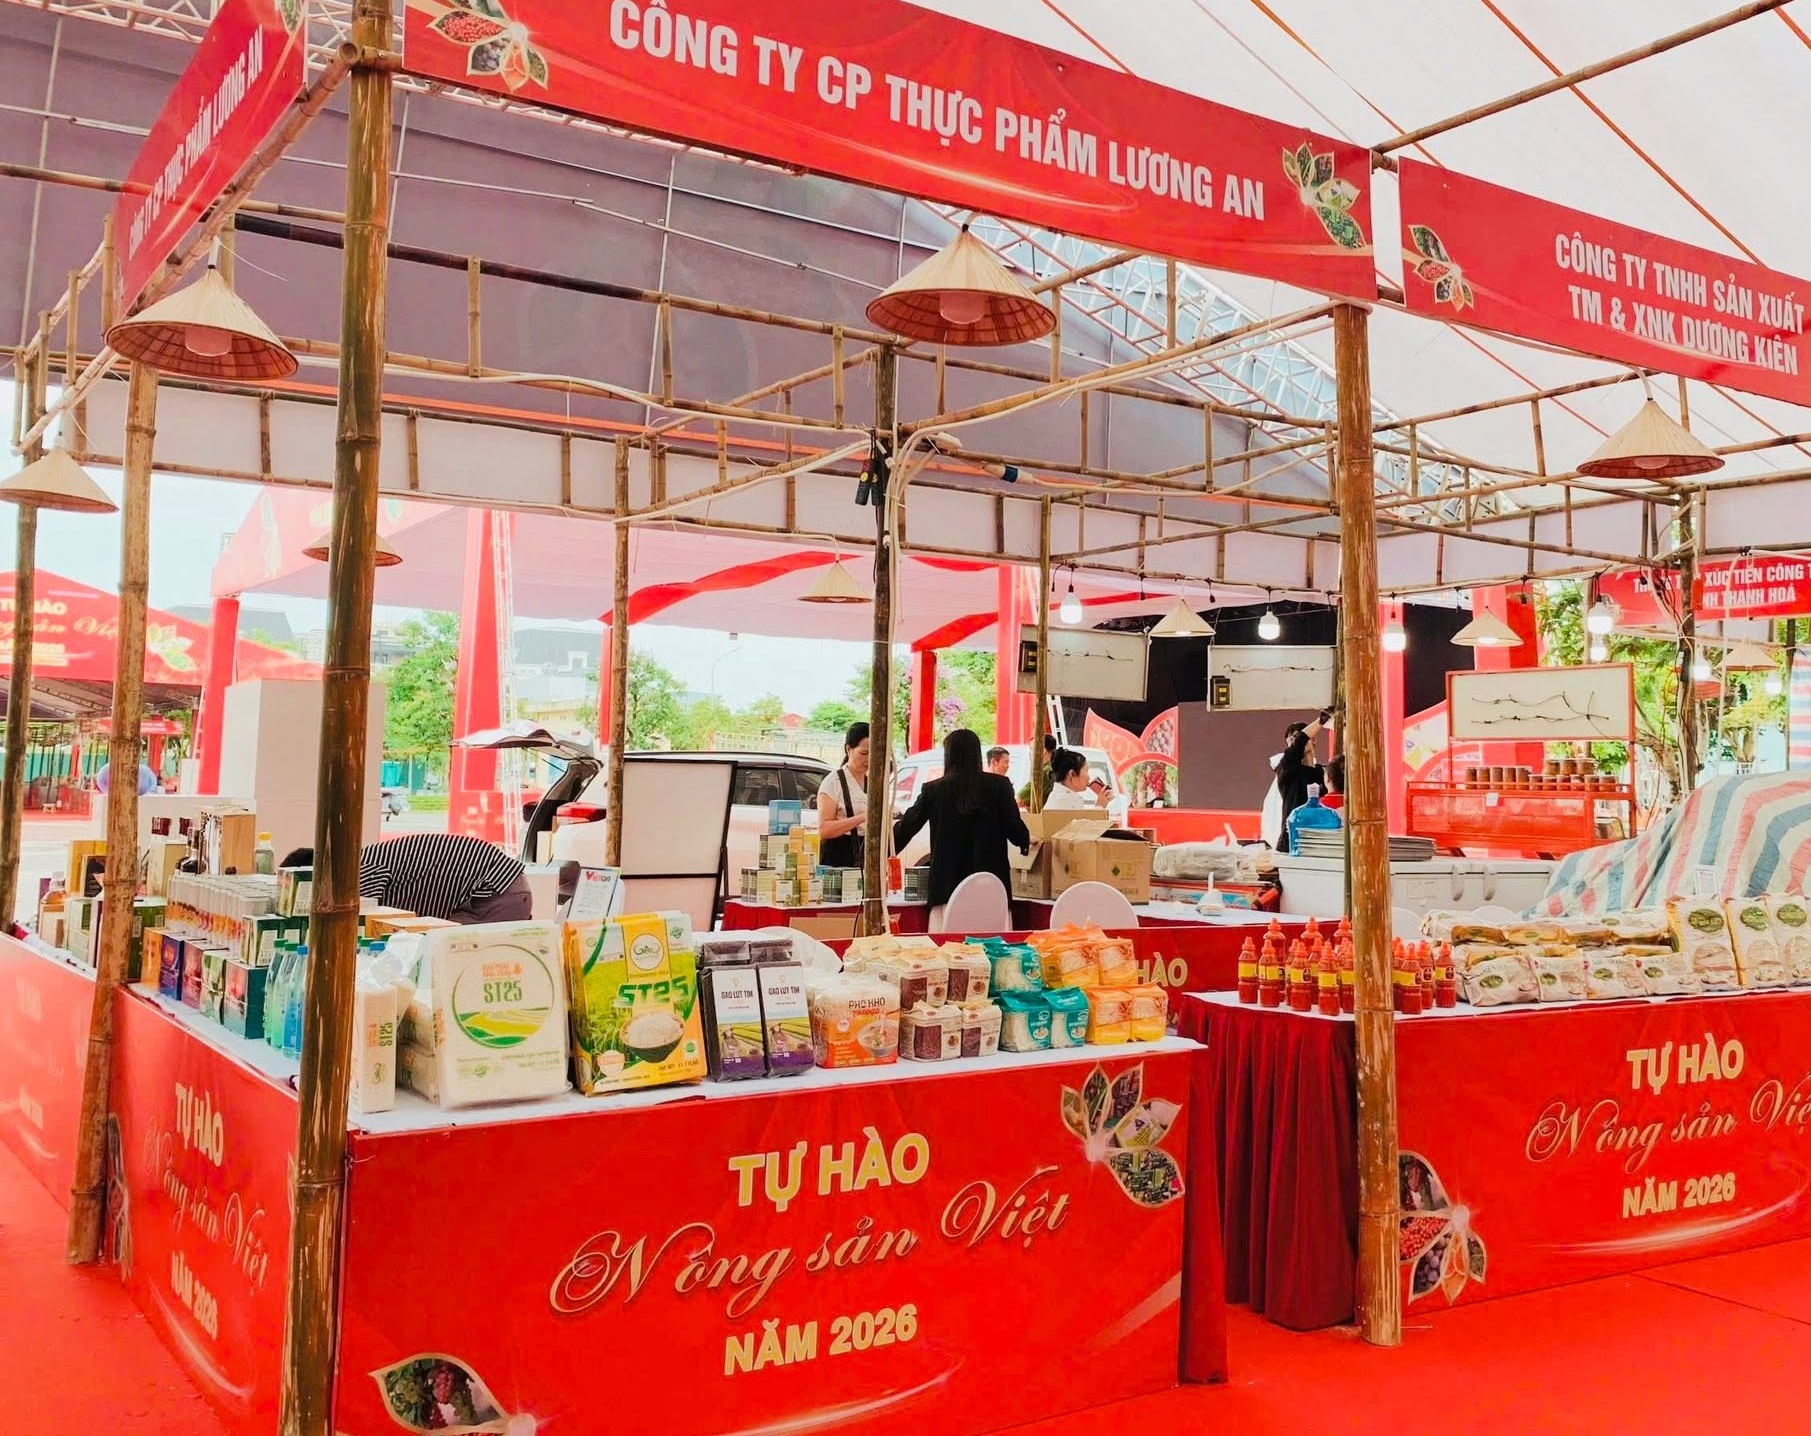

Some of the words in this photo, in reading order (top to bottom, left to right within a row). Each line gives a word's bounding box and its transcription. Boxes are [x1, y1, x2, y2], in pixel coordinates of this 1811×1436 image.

[246, 23, 263, 90] AN
[610, 0, 738, 77] CÔNG
[753, 35, 804, 93] TY
[816, 56, 872, 111] CP
[885, 74, 983, 147] THỰC
[995, 106, 1097, 178] PHẨM
[1108, 140, 1214, 208] LƯƠNG
[1222, 173, 1266, 221] AN
[1555, 232, 1617, 283] CÔNG
[1622, 252, 1647, 290] TY
[1653, 264, 1707, 307] TNHH
[1712, 273, 1753, 317] SẢN
[1758, 289, 1805, 335] XUẤT
[1568, 285, 1603, 326] TM
[1610, 297, 1627, 331] &
[1632, 302, 1677, 345] XNK
[1682, 314, 1750, 362] DƯƠNG
[1753, 334, 1799, 376] KIÊN
[1705, 570, 1729, 587] XÚC
[1767, 562, 1804, 581] CÔNG
[1723, 588, 1765, 607] THANH
[73, 616, 119, 641] Việ
[483, 979, 523, 1004] ST25
[618, 975, 689, 1007] ST25
[1137, 952, 1188, 987] HÀO
[379, 1022, 393, 1047] ST25
[1626, 1040, 1674, 1096] TỰ
[1676, 1032, 1745, 1085] HÀO
[175, 1082, 194, 1151] TỰ
[193, 1089, 224, 1168] HÀO
[1525, 1098, 1664, 1175] Nông
[1671, 1101, 1737, 1143] sản
[1750, 1073, 1811, 1134] Việ
[727, 1141, 808, 1213] TỰ
[817, 1126, 931, 1196] HÀO
[1622, 1175, 1678, 1219] NĂM
[1683, 1171, 1737, 1209] 2026
[224, 1191, 268, 1298] Việt
[548, 1220, 796, 1319] Nông
[804, 1214, 921, 1273] sản
[939, 1165, 1071, 1250] Việt
[723, 1319, 818, 1376] NĂM
[829, 1302, 918, 1356] 2026
